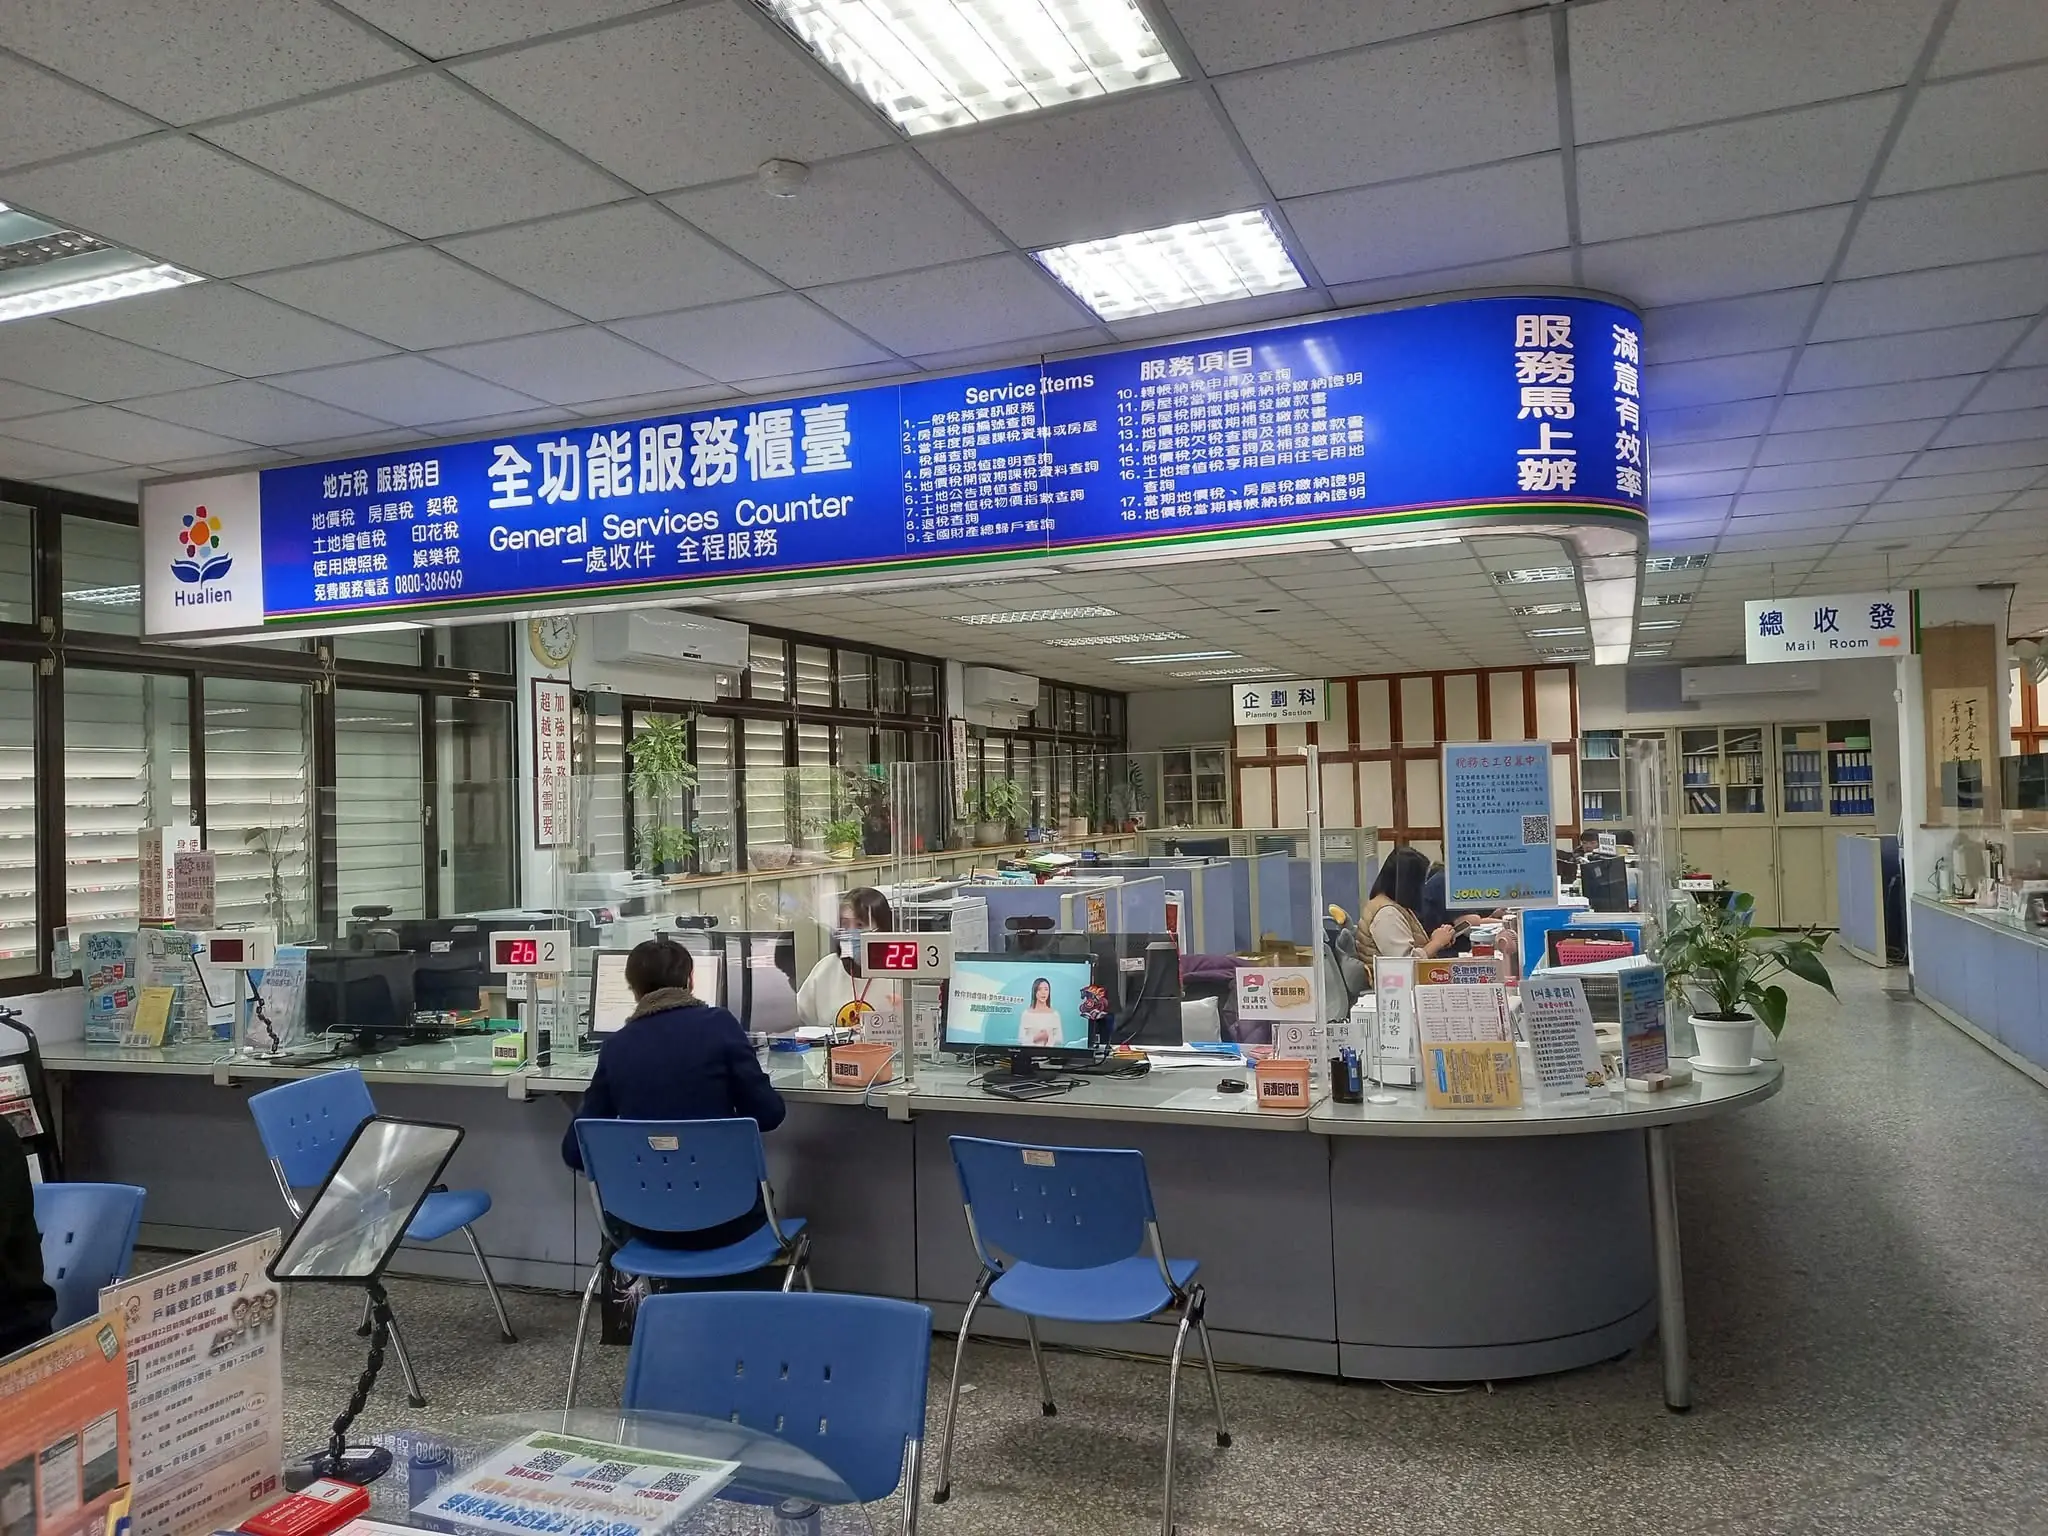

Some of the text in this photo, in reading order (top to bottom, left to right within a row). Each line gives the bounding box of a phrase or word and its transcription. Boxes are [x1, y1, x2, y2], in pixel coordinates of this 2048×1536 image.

[1140, 347, 1253, 381] 服務項目
[966, 374, 1094, 404] Service Items
[1514, 314, 1577, 491] 服務馬上辦
[1612, 323, 1642, 498] 滿意有效率
[488, 403, 853, 509] 全功能服務櫃臺
[323, 459, 440, 499] 地方稅 服務稅目
[1143, 479, 1175, 494] 查詢
[312, 496, 458, 530] 地價稅 房屋稅 契稅
[489, 493, 853, 551] General Services Counter
[312, 521, 459, 555] 土地增值稅 印花稅
[561, 528, 778, 573] 一處收件 全程服務
[313, 546, 460, 577] 使用牌照稅 娛樂稅
[175, 588, 233, 607] Hualien
[314, 570, 463, 602] 免費服務電話 0800-386969
[1759, 603, 1896, 636] 總收發
[1785, 638, 1869, 652] Mail Room
[1242, 688, 1316, 709] 企劃科
[1246, 708, 1312, 719] Planning Section
[540, 692, 553, 836] 超越民眾需要
[1453, 887, 1501, 900] JOIN US
[249, 941, 255, 961] 1
[510, 941, 535, 964] 26
[544, 941, 556, 963] 2
[885, 944, 917, 969] 22
[926, 945, 940, 968] 3
[1272, 987, 1306, 996] 客語服務
[153, 1261, 237, 1300] 自住房屋要節稅
